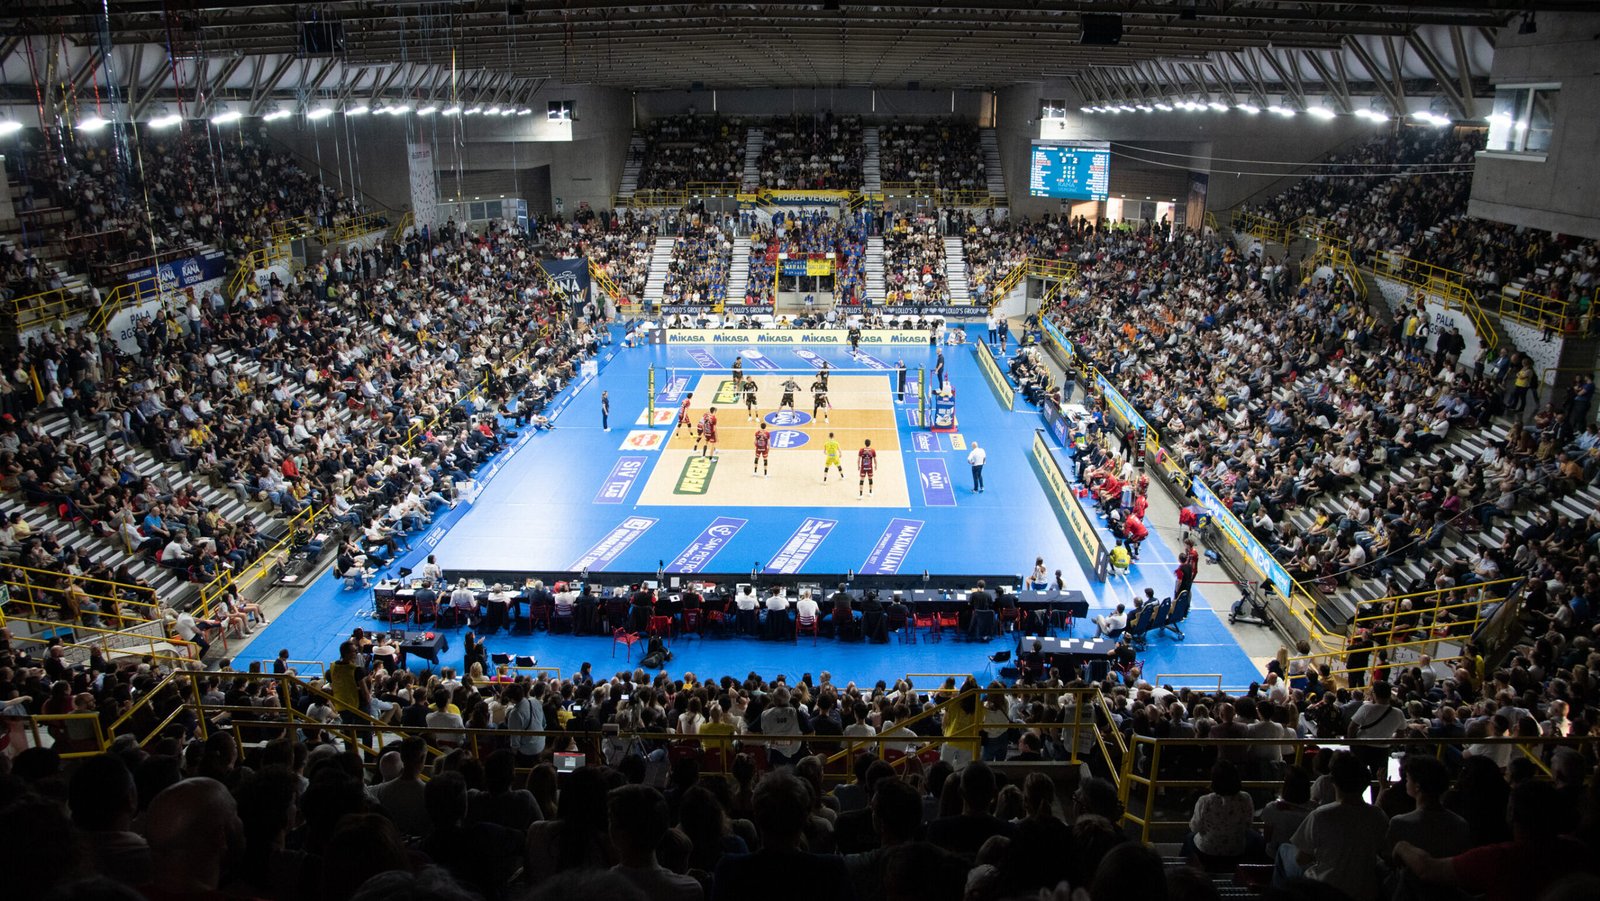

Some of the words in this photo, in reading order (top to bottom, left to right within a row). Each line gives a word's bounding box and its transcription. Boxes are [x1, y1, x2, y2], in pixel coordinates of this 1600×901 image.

[161, 270, 176, 282] ANA
[182, 264, 200, 276] RANA
[1436, 313, 1454, 328] PALA
[669, 332, 705, 342] MIKASA
[713, 332, 749, 342] MIKASA
[757, 332, 793, 342] MIKASA
[802, 332, 838, 342] MIKASA
[890, 333, 927, 343] MIKASA
[702, 537, 722, 550] SAN
[879, 524, 917, 571] MAXIMILIAN
